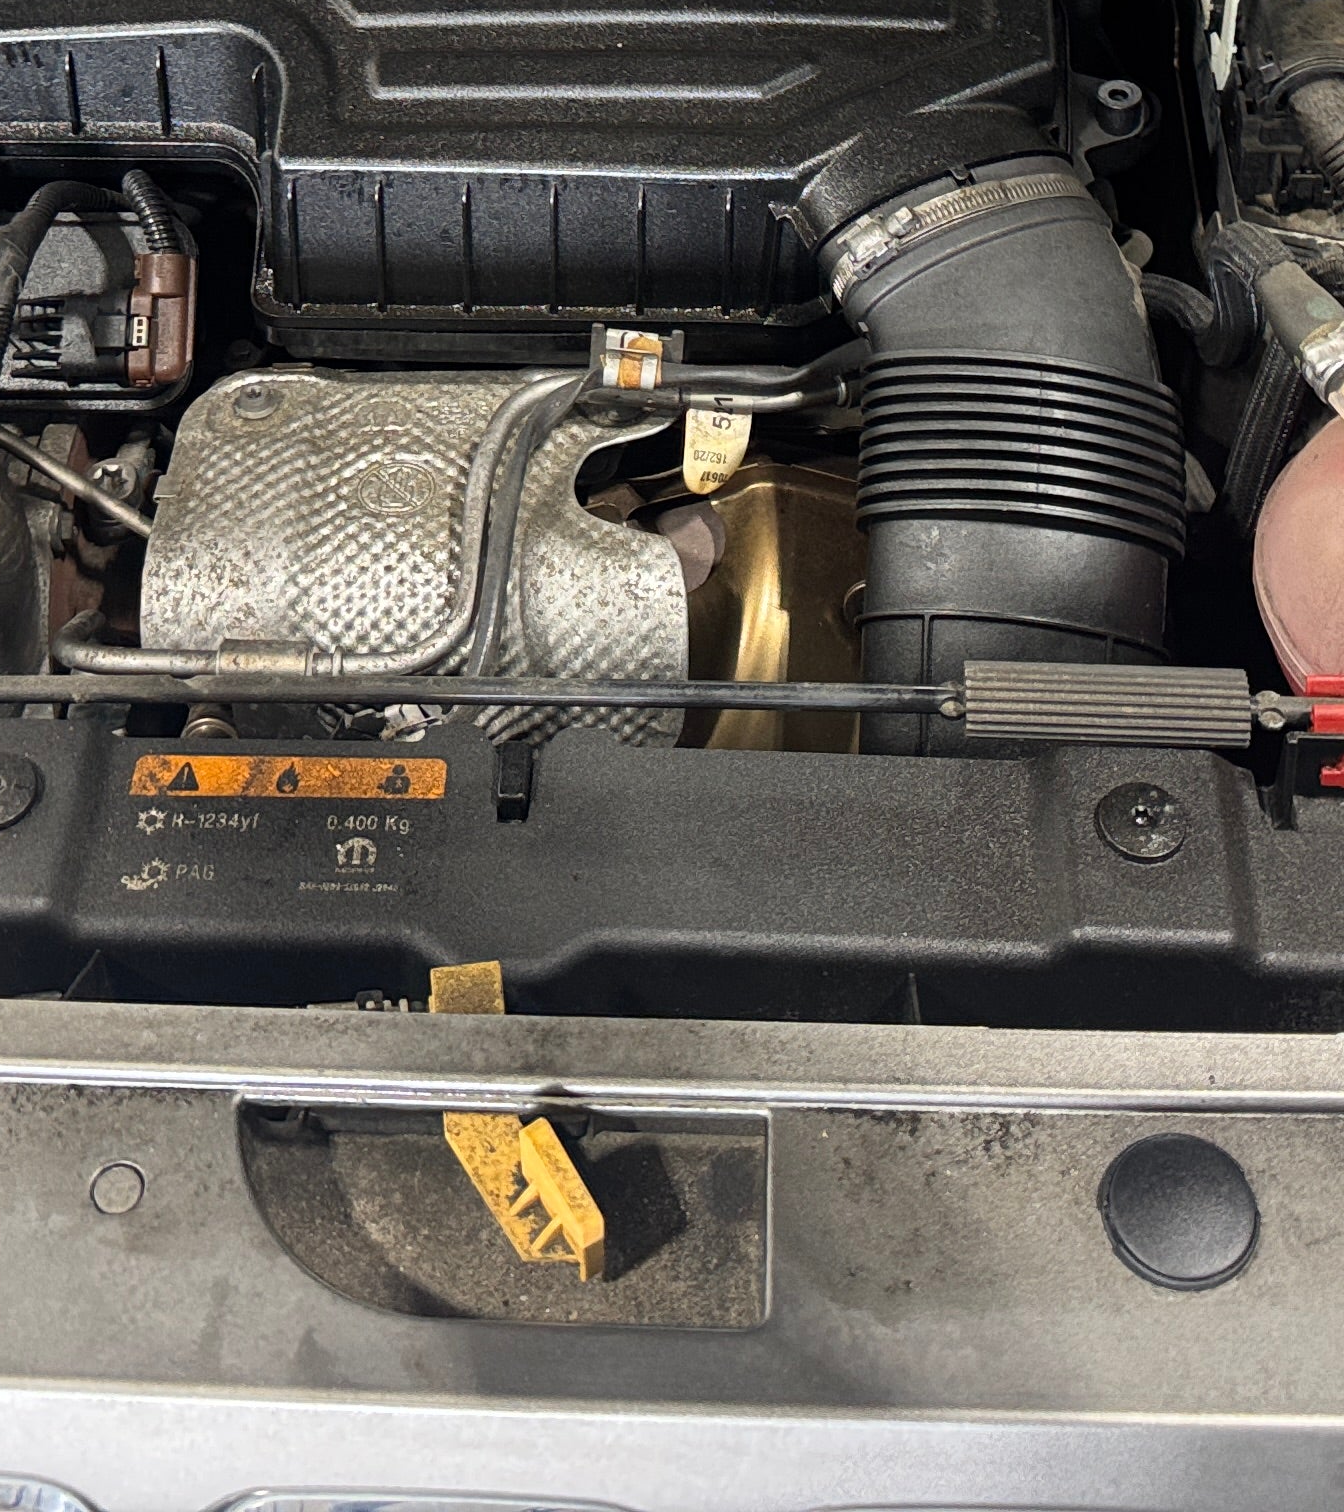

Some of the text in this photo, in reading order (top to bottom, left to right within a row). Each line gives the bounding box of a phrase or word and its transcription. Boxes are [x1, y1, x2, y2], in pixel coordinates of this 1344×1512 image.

[693, 449, 727, 465] 162/20
[326, 814, 379, 831] 0.400
[384, 815, 410, 835] Kg
[175, 864, 216, 881] PAG
